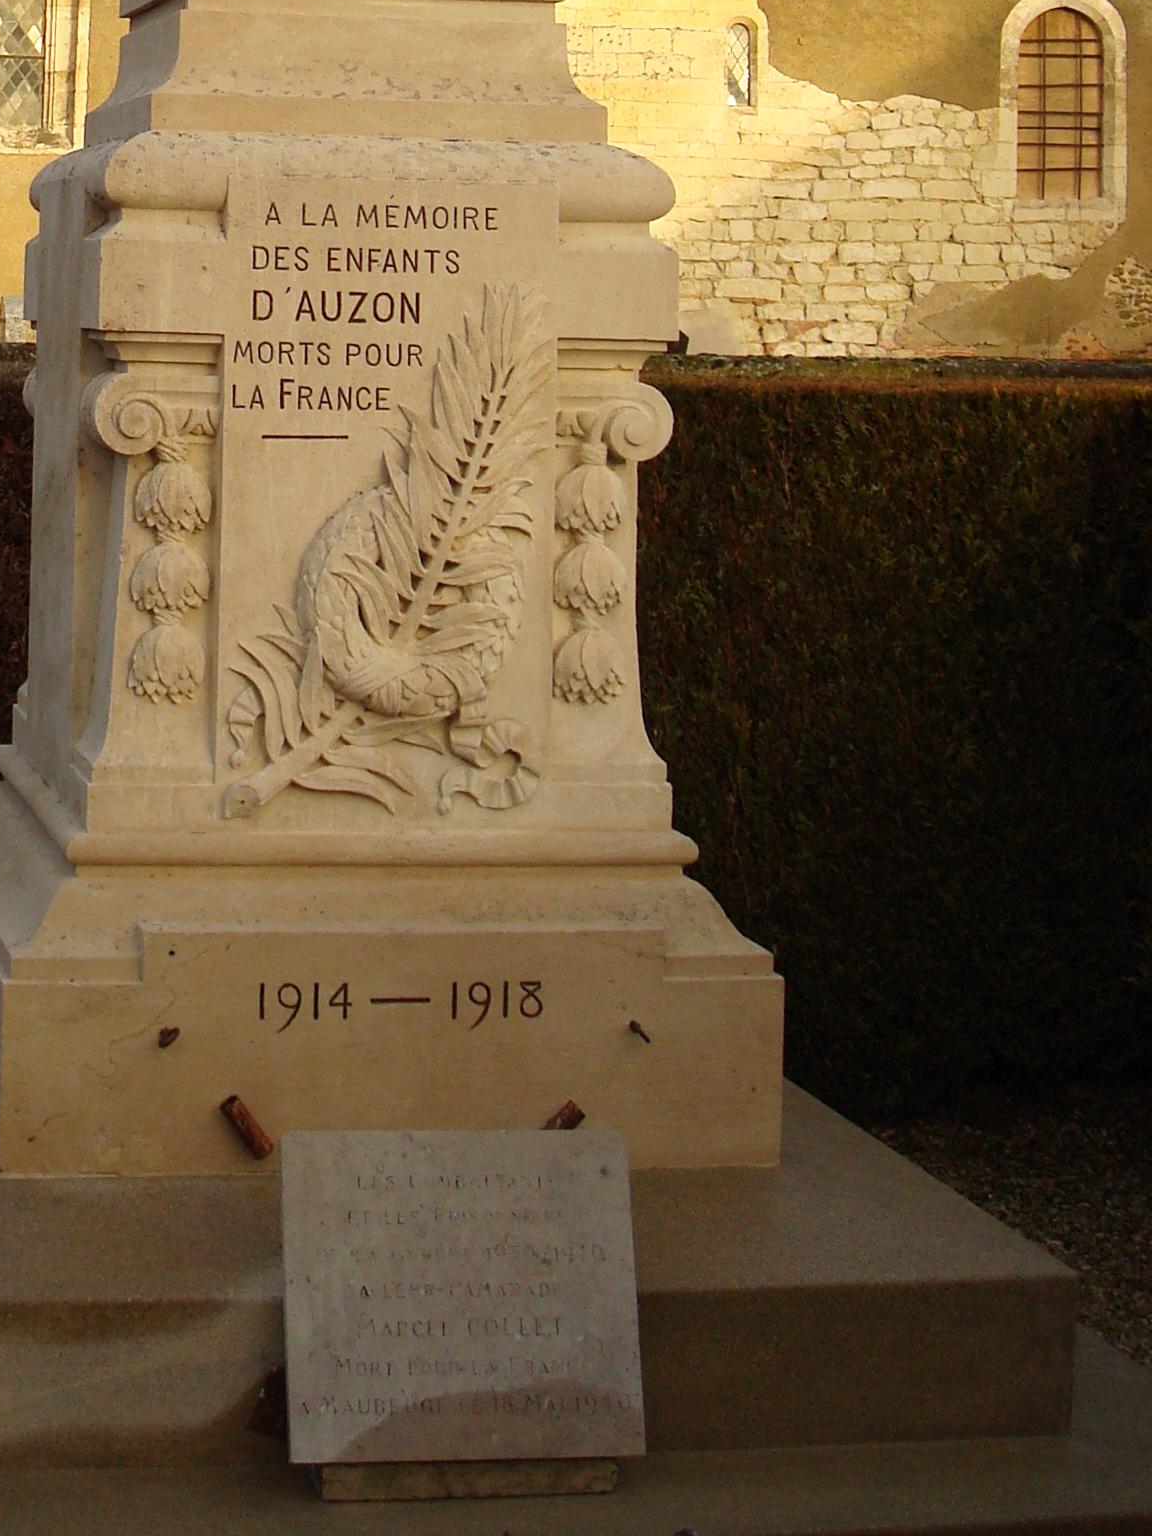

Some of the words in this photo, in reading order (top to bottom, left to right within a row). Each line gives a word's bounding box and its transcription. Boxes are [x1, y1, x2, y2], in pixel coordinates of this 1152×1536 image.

[265, 202, 281, 226] A
[301, 203, 338, 227] LA
[356, 195, 499, 230] MÉMOIRE
[252, 245, 309, 271] DES
[327, 248, 460, 274] ENFANTS
[233, 341, 331, 365] MORTS
[346, 343, 423, 367] POUR
[232, 384, 264, 410] LA
[279, 379, 391, 411] FRANCE
[259, 982, 352, 1033] 1914
[451, 981, 543, 1031] 1918
[467, 1316, 561, 1337] COLLET
